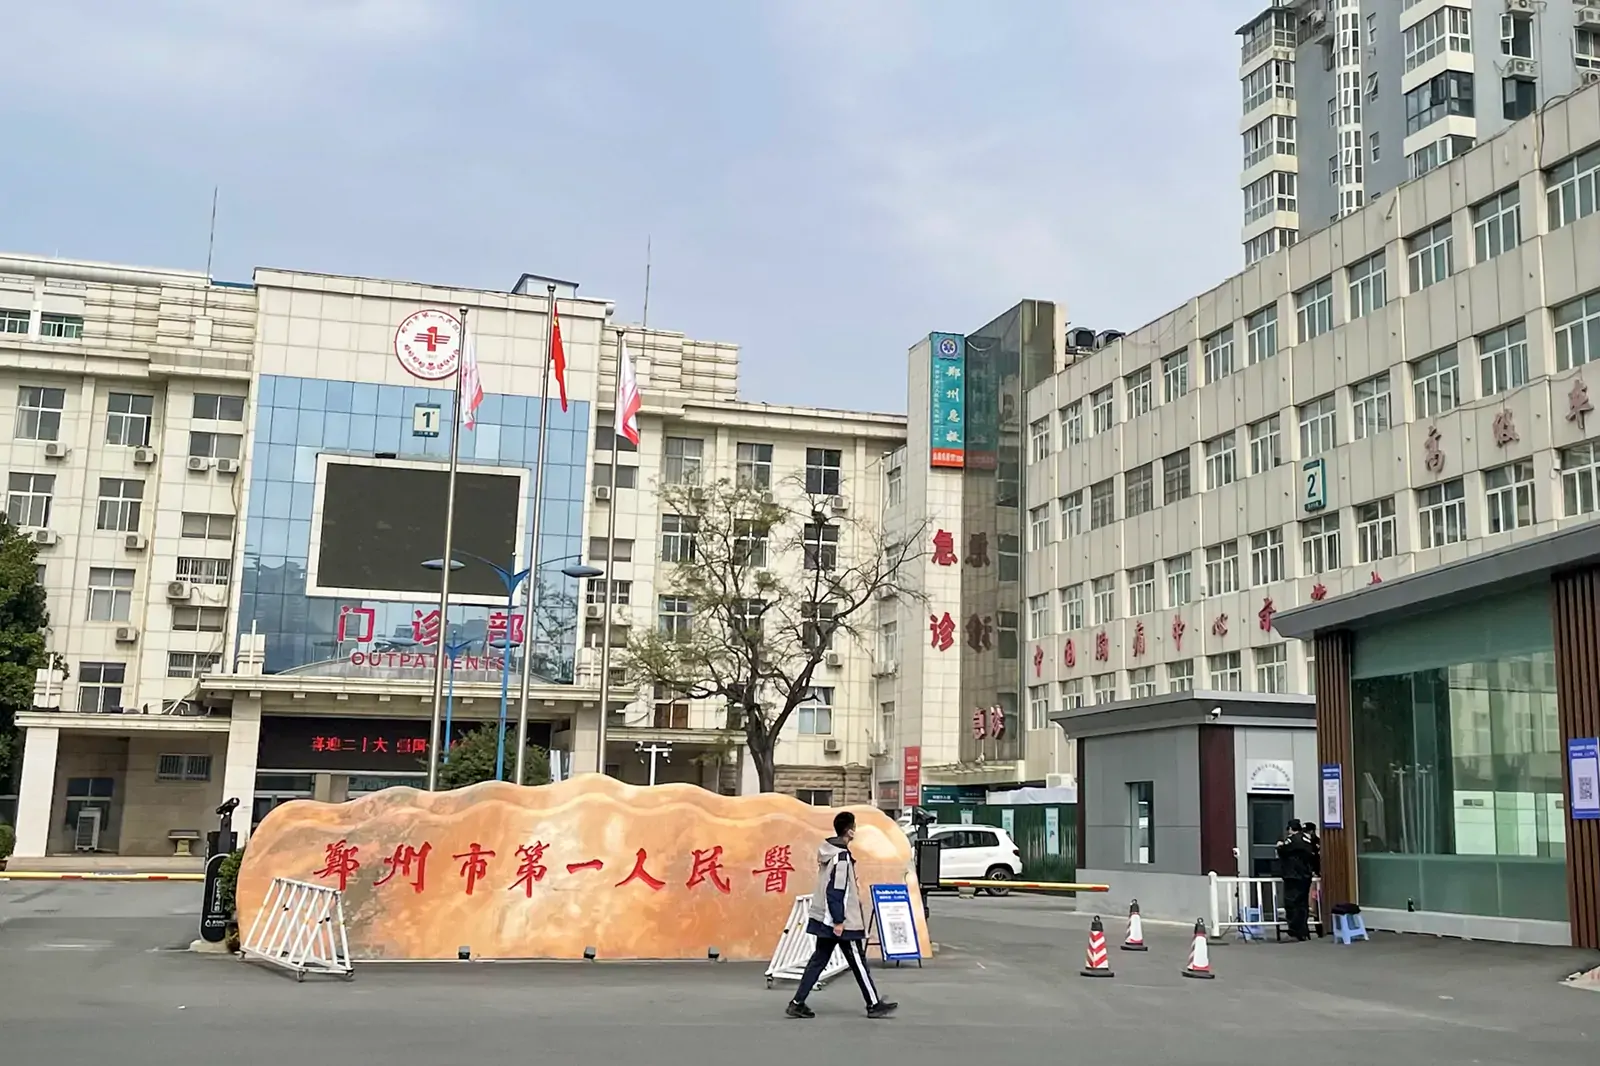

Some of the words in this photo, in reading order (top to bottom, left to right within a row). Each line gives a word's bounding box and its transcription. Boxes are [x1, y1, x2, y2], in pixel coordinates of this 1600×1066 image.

[931, 529, 958, 652] 急诊
[337, 605, 525, 646] 门诊部
[972, 704, 1006, 740] 急诊
